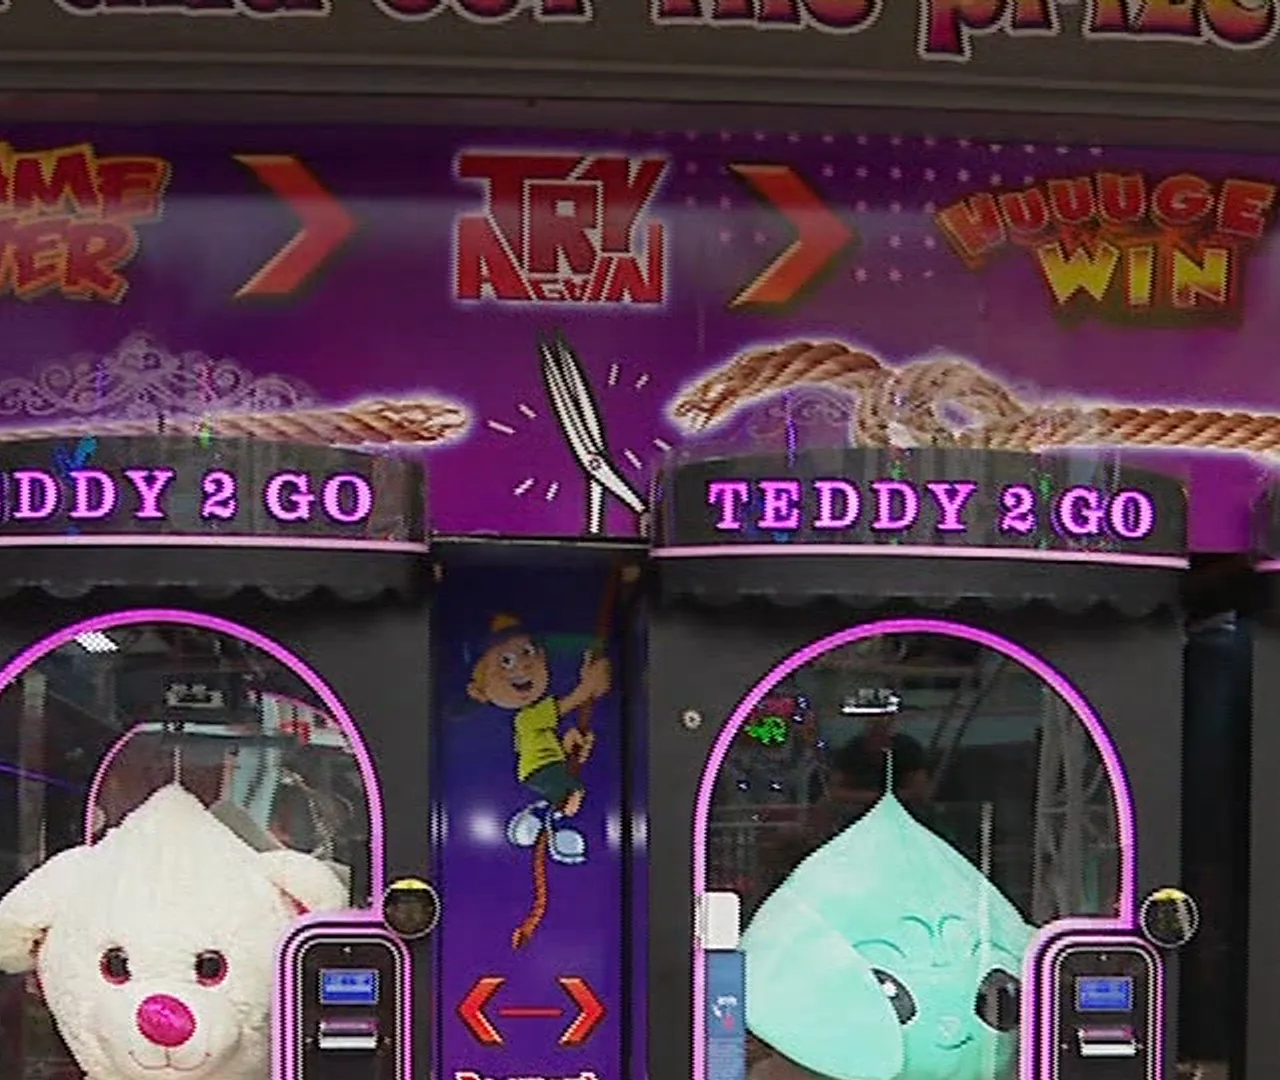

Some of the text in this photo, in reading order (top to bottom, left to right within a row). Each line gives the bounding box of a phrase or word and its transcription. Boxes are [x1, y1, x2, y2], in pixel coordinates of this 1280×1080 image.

[455, 150, 668, 278] TRY
[934, 172, 1275, 262] HUUUGE
[1038, 242, 1235, 306] WIN
[201, 472, 237, 518] 2
[265, 473, 373, 522] GO
[708, 481, 1154, 538] TEDDY 2 GO
